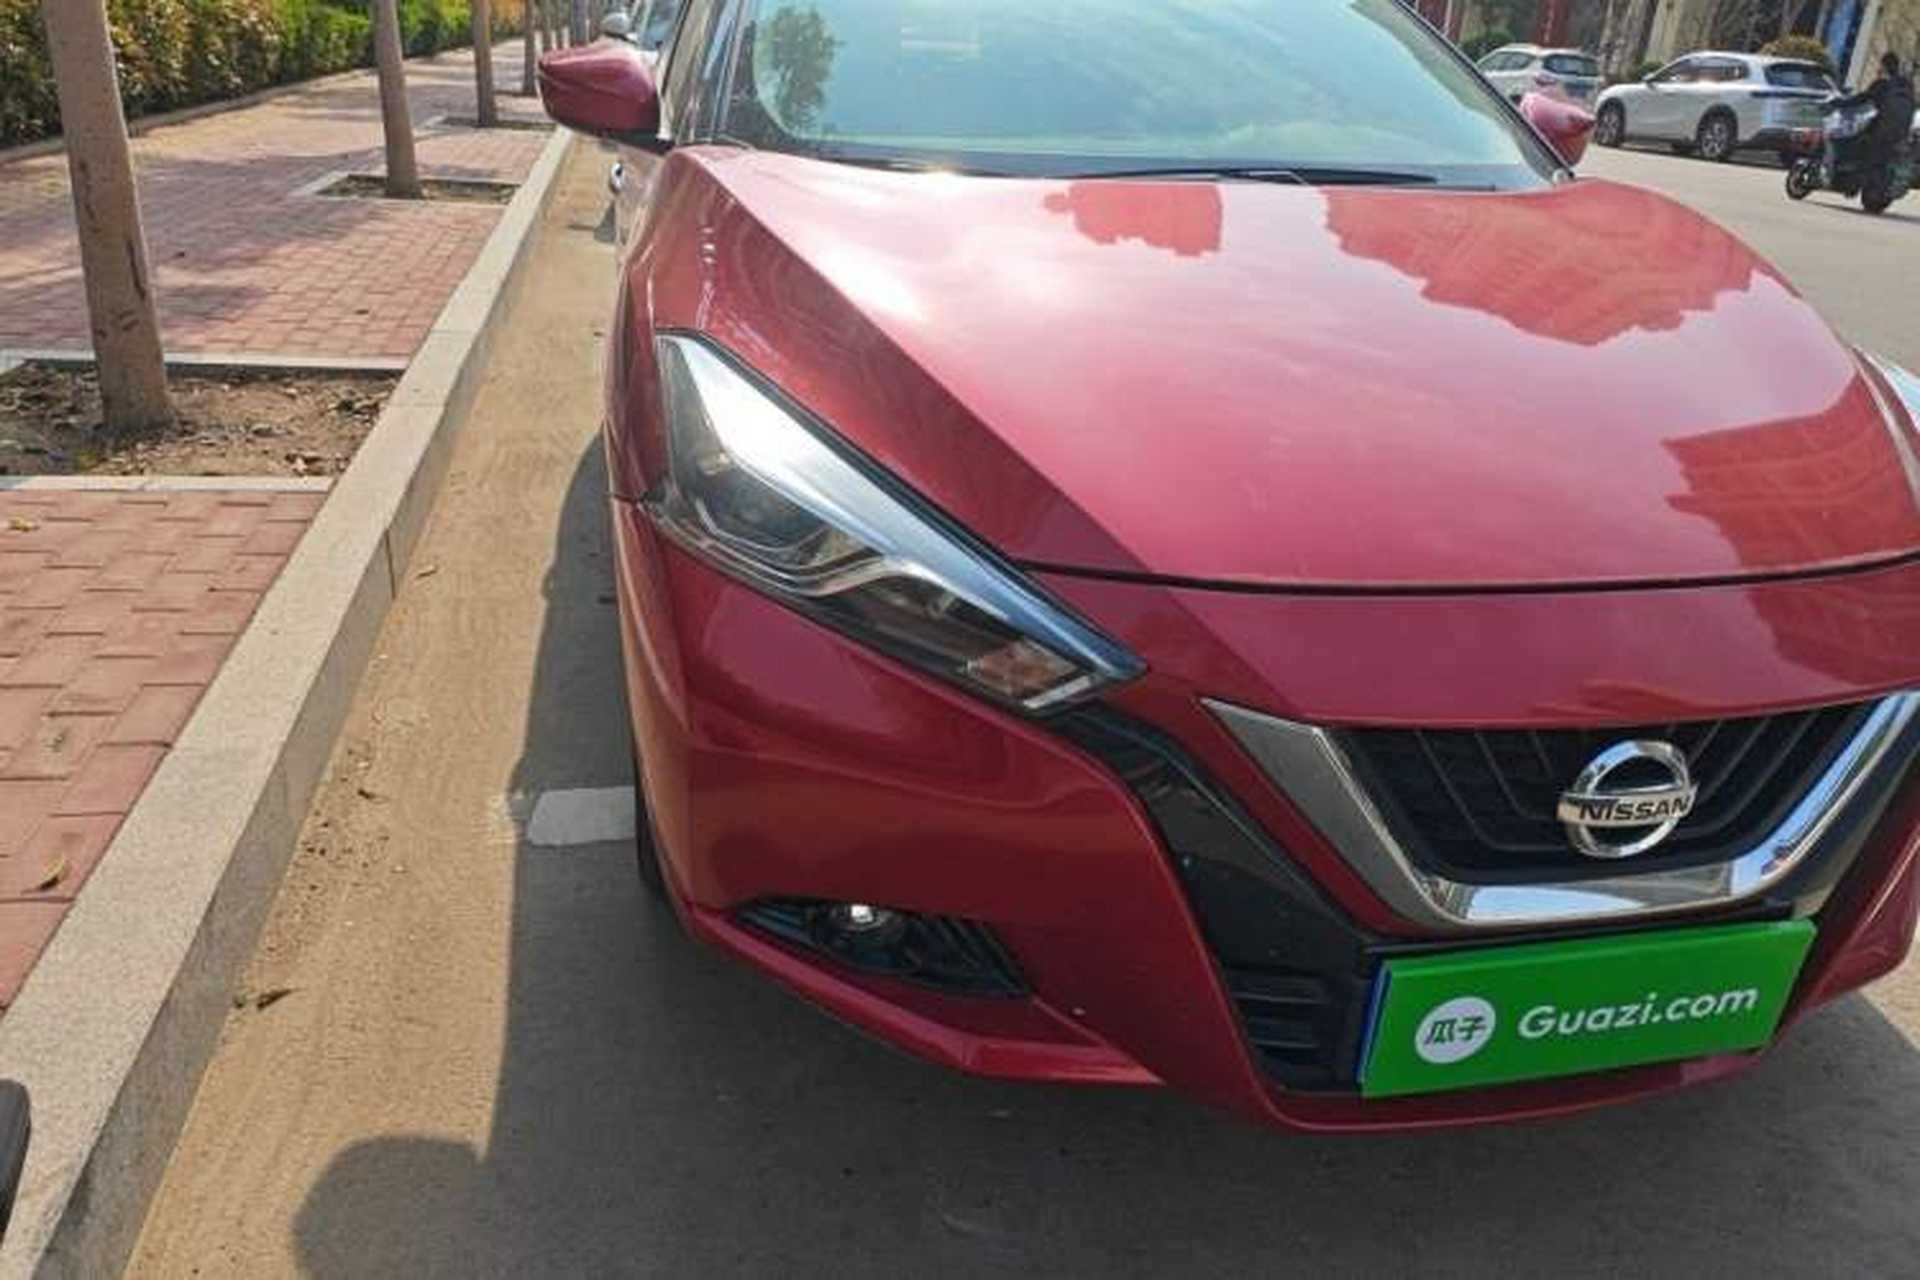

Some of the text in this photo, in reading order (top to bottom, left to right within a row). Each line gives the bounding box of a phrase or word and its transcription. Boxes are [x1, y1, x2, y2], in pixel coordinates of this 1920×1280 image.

[1579, 797, 1689, 820] NISSAN
[1518, 988, 1757, 1037] Guazi.com
[1424, 1016, 1486, 1045] 瓜子
